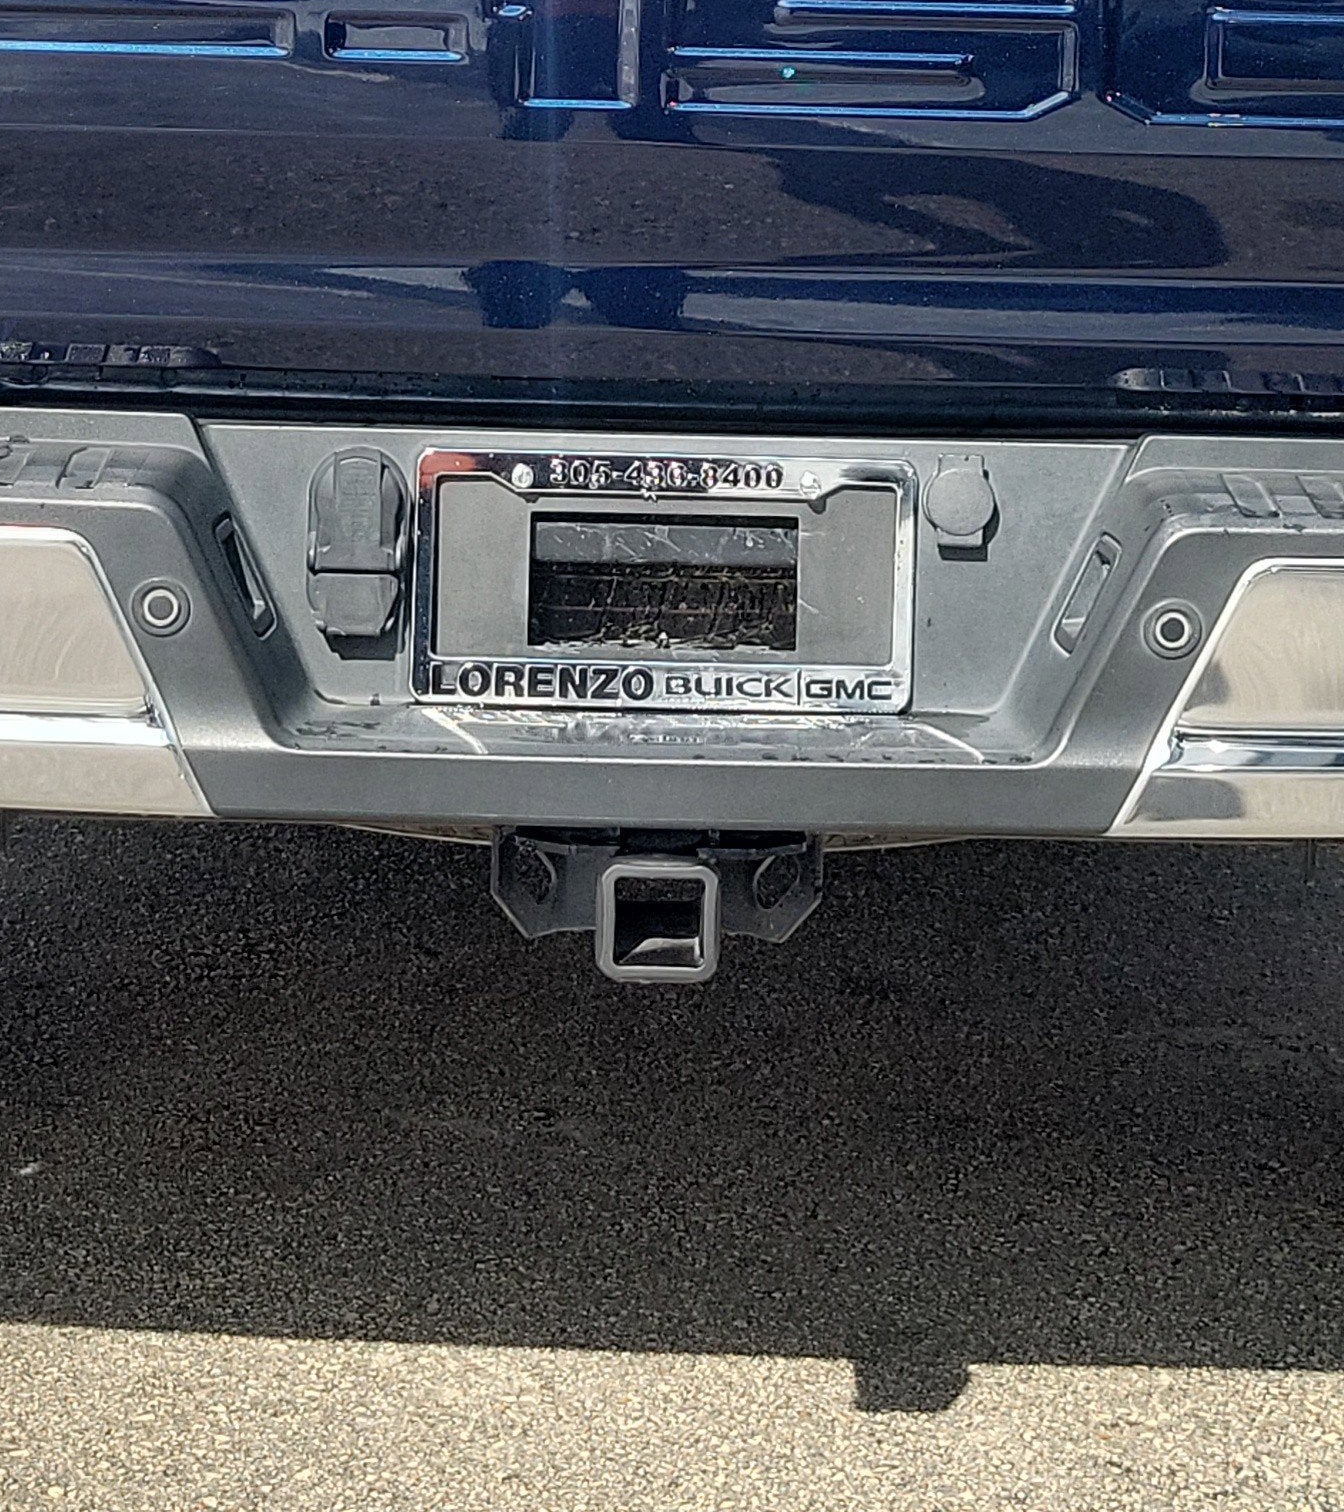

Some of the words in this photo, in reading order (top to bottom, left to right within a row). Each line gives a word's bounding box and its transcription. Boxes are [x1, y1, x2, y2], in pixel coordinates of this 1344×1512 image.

[429, 661, 655, 702] LORENZO
[664, 675, 793, 699] BUICK
[804, 677, 894, 701] GMC
